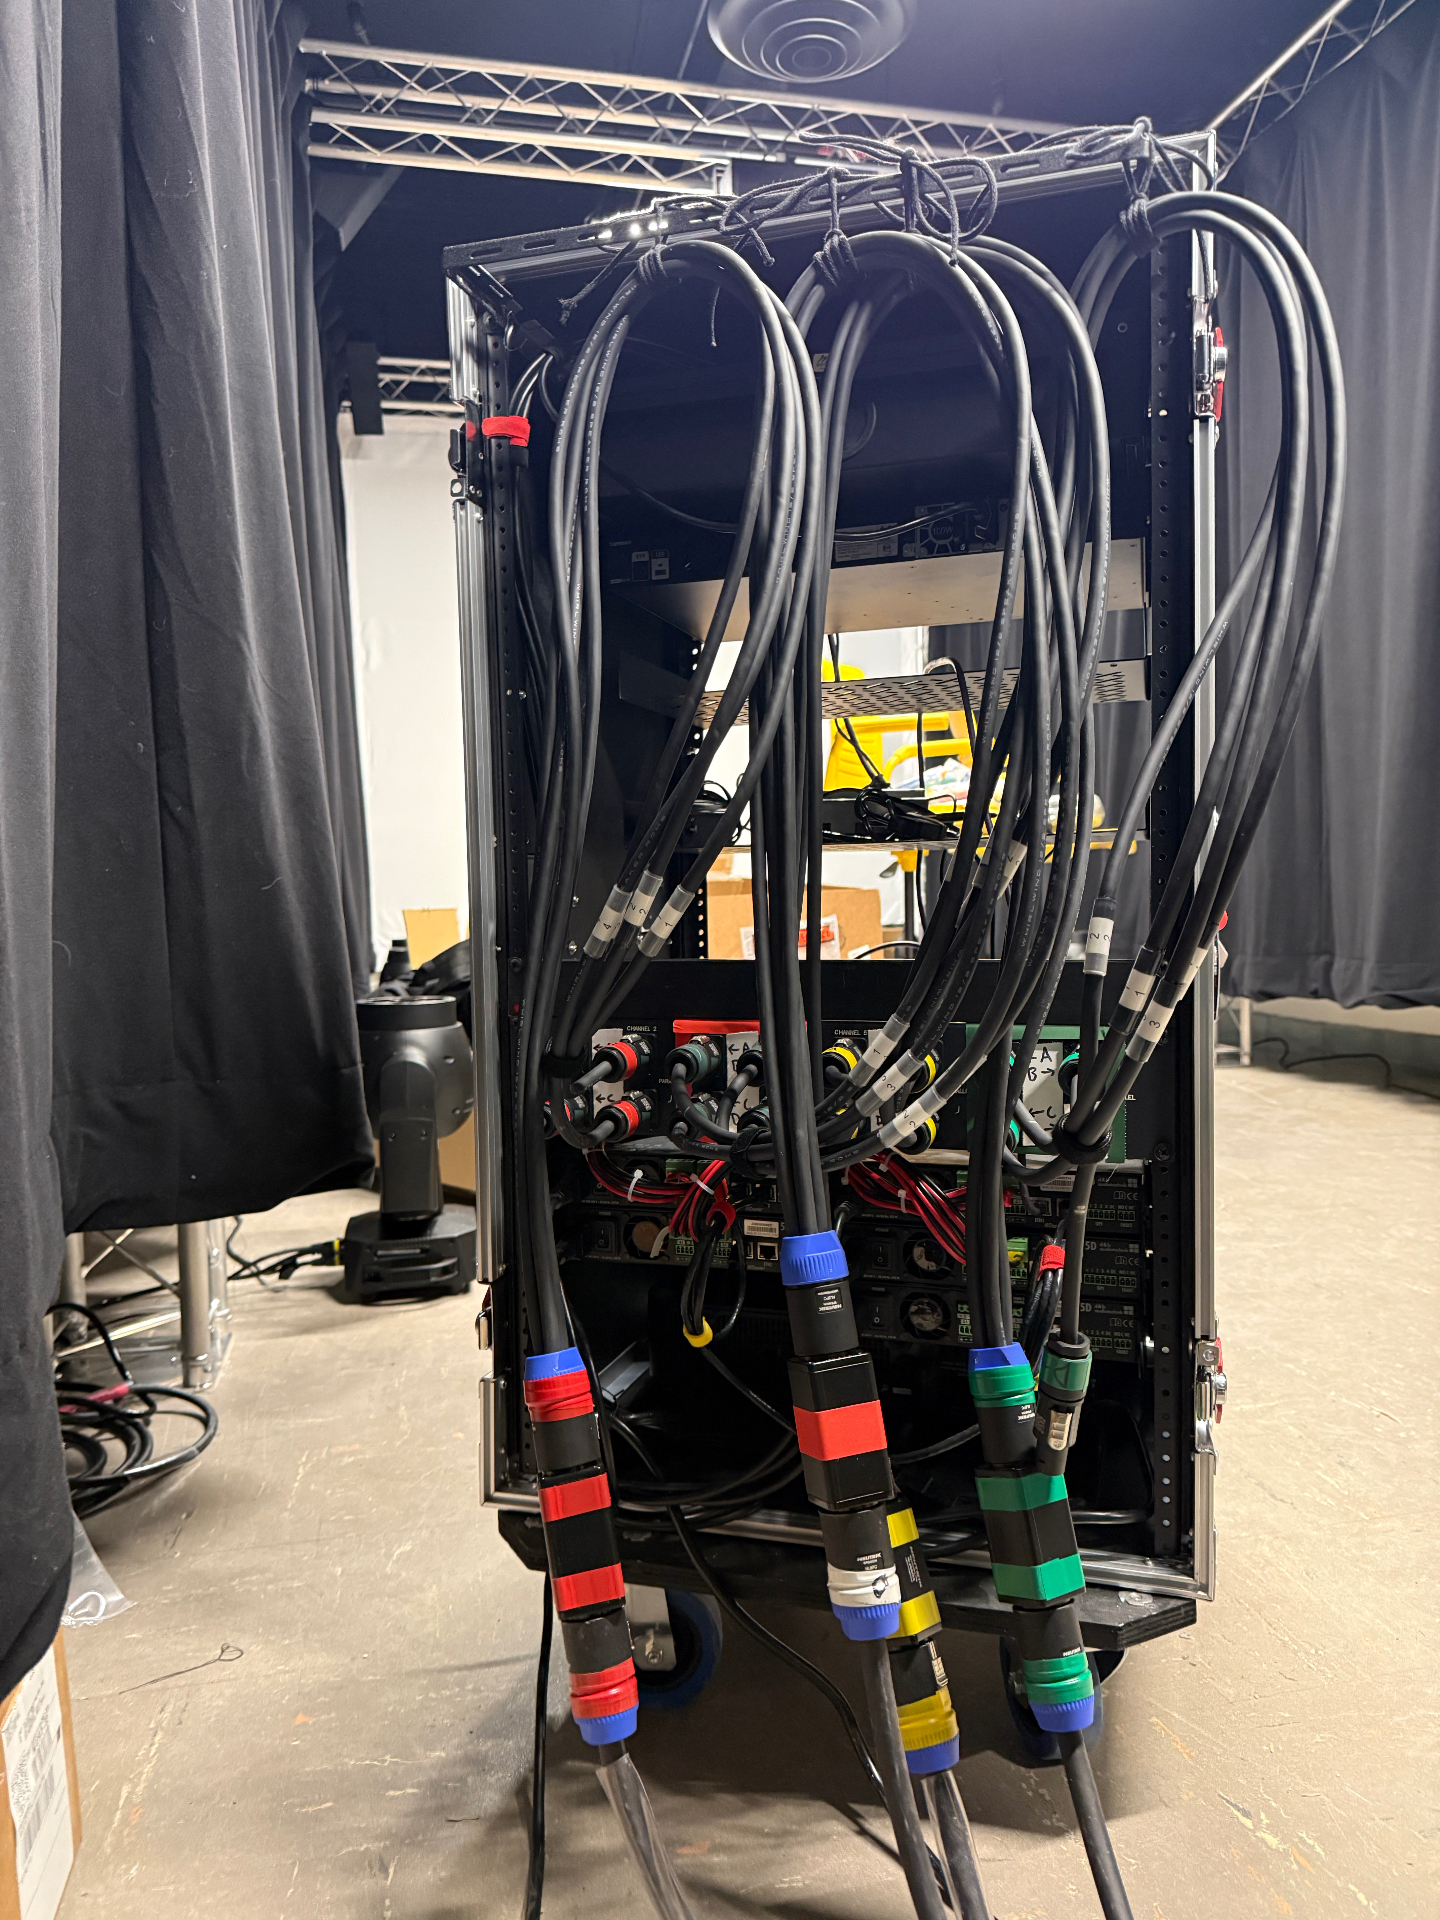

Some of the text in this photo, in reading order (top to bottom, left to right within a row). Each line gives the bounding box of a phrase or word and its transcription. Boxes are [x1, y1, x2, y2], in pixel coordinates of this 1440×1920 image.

[599, 313, 630, 378] WHIRLWIND
[1195, 620, 1229, 686] WHIRLWIND
[982, 667, 998, 745] WHIRLWIND
[1020, 868, 1043, 949] WHIRLWIND
[1148, 1018, 1162, 1030] 3
[834, 1029, 861, 1037] CHANNEL
[1039, 1046, 1053, 1063] A
[1027, 1066, 1038, 1082] B
[1084, 1240, 1097, 1251] 5D
[1079, 1302, 1093, 1313] 5D
